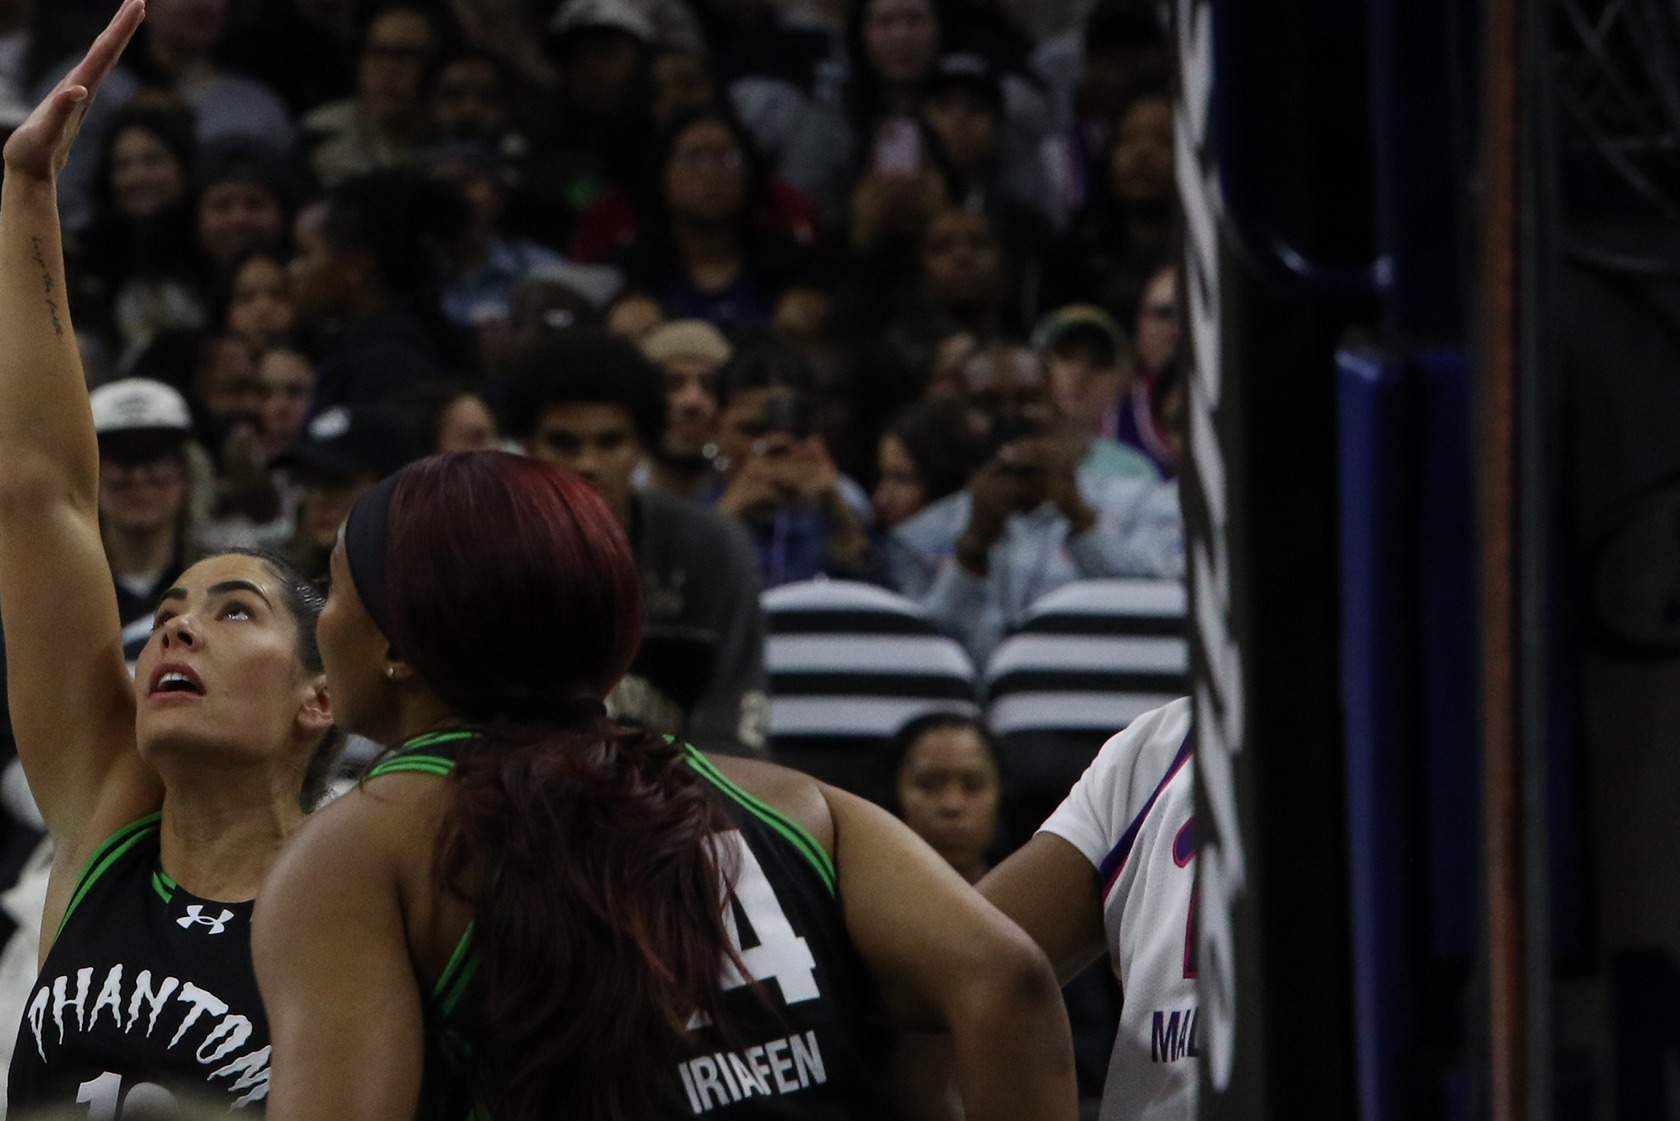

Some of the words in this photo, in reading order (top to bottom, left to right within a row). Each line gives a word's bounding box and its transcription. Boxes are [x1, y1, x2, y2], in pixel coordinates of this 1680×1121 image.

[685, 828, 822, 1031] 4
[27, 963, 272, 1114] PHANTOM
[76, 1070, 182, 1121] 1
[677, 1030, 827, 1116] IRIAFEN
